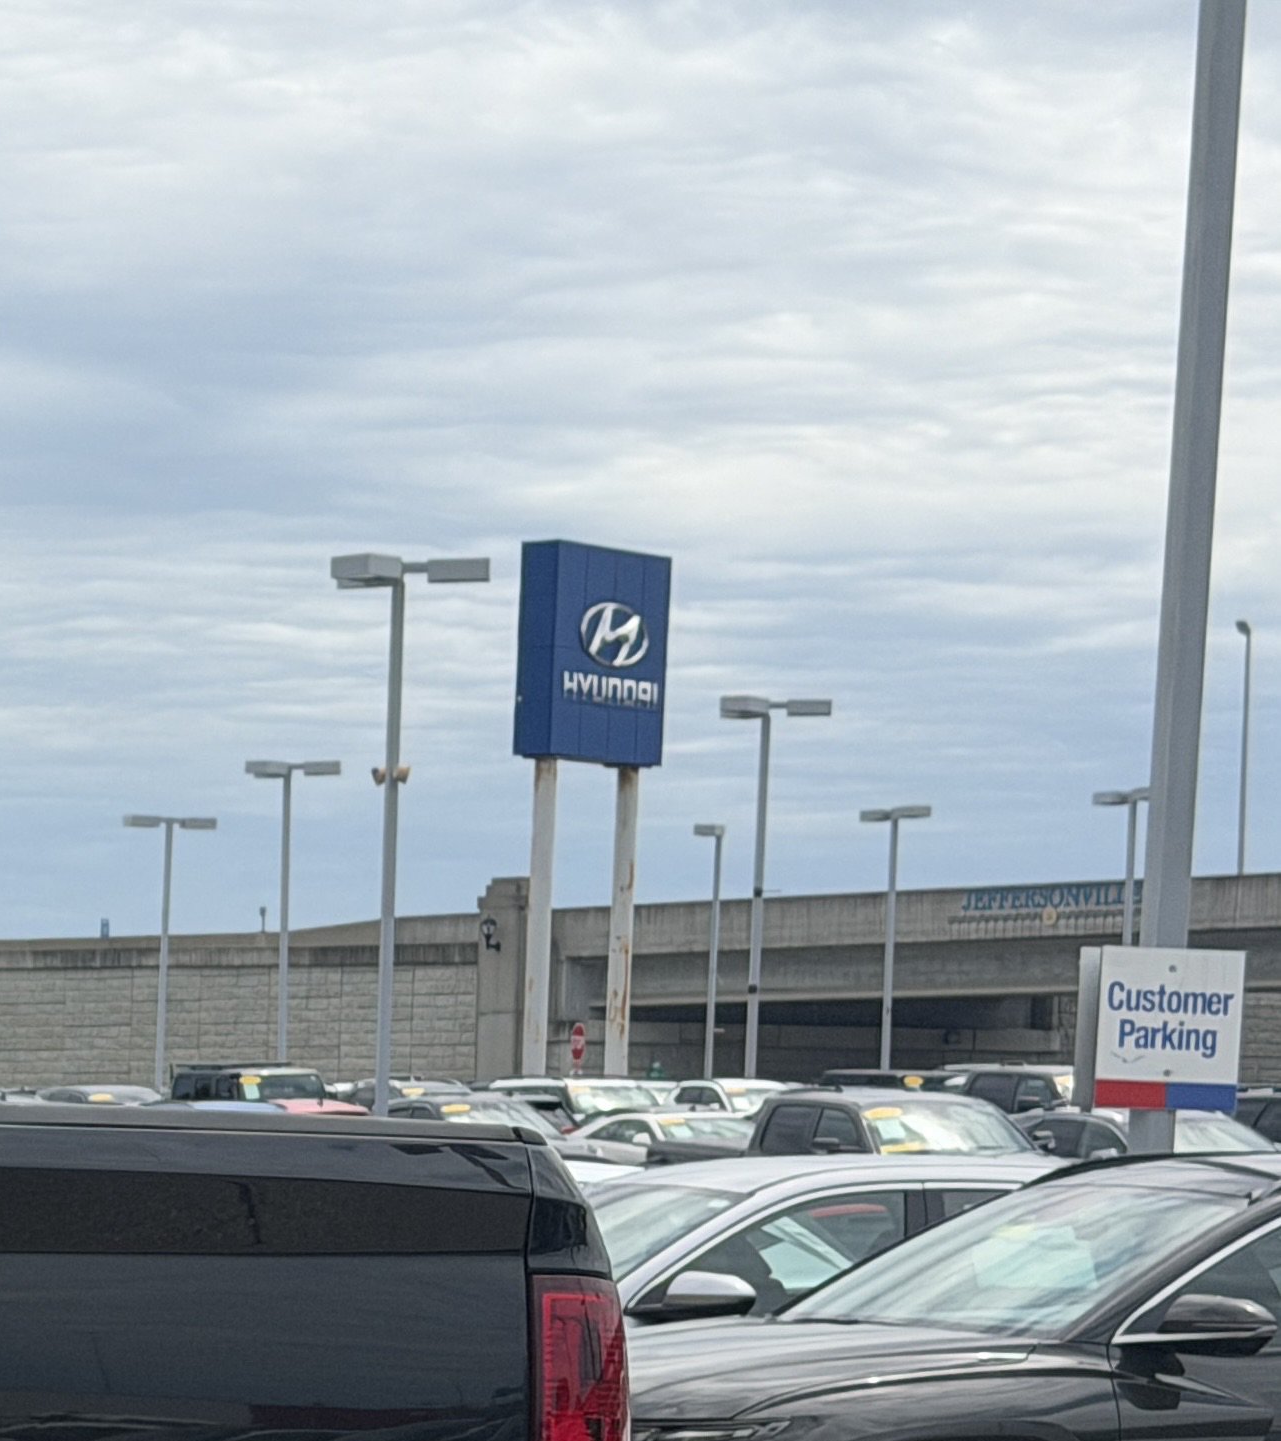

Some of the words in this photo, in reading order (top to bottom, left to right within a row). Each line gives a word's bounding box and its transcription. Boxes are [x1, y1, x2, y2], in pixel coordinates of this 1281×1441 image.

[563, 671, 658, 707] HYUNDAI
[1108, 981, 1234, 1016] Customer
[1118, 1018, 1217, 1059] Parking
